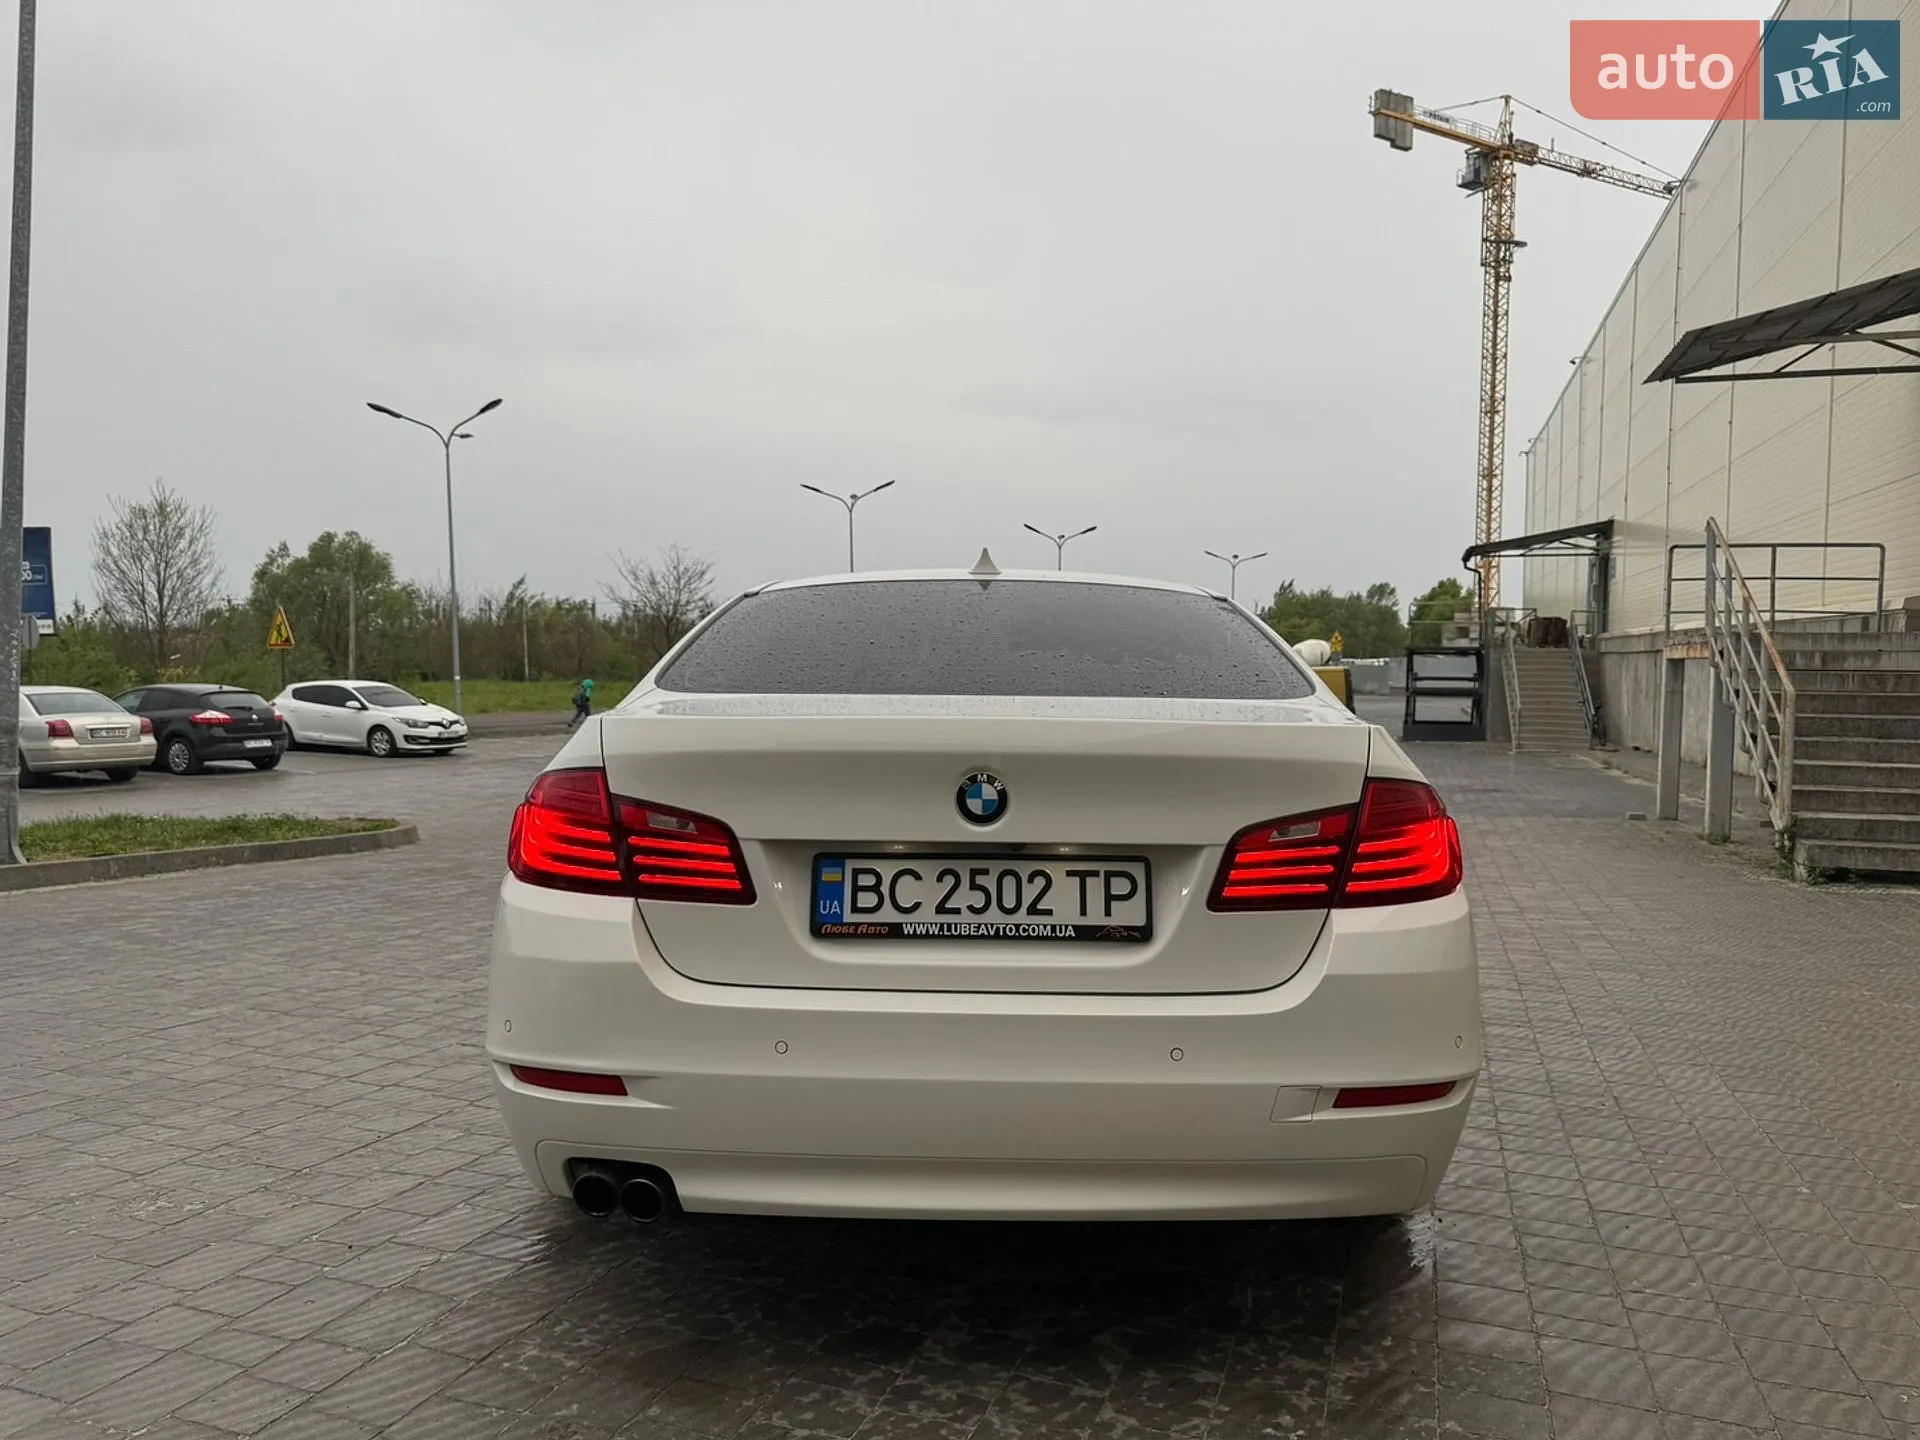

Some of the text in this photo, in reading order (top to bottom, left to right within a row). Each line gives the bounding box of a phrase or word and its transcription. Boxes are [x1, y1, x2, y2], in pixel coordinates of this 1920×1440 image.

[961, 773, 1004, 791] BMW
[850, 867, 1139, 917] BC 2502 TP
[819, 899, 841, 914] UA
[902, 923, 1076, 937] WWW.LUBEAVTO.COM.UA
